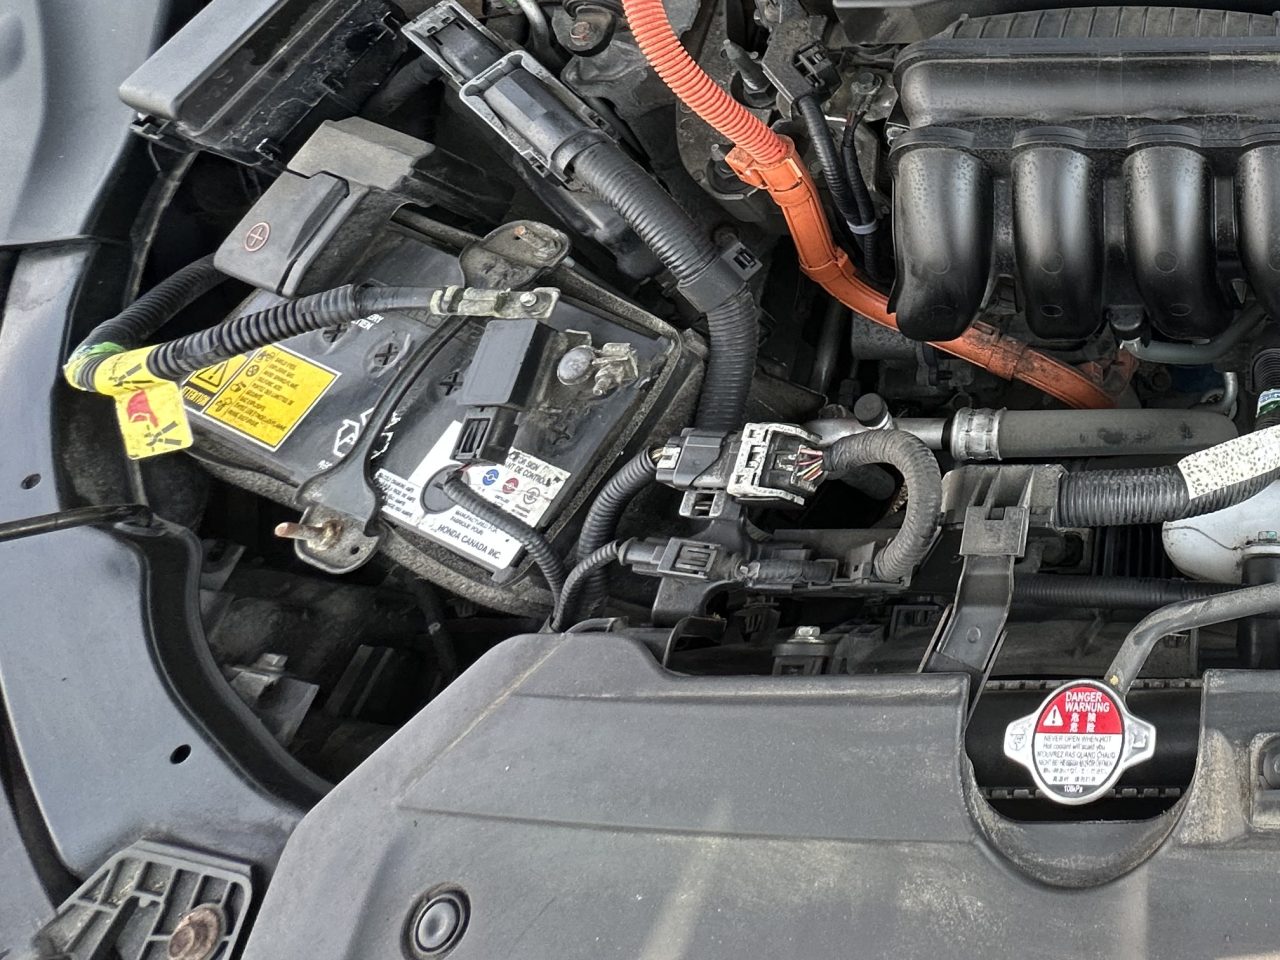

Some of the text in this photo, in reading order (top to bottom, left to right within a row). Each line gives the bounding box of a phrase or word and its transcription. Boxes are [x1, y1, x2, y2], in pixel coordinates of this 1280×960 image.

[436, 523, 460, 541] HONDA
[461, 534, 488, 554] CANADA
[1065, 691, 1103, 702] DANGER
[1065, 702, 1110, 712] WARNUNG
[1064, 785, 1083, 793] 108kPa
